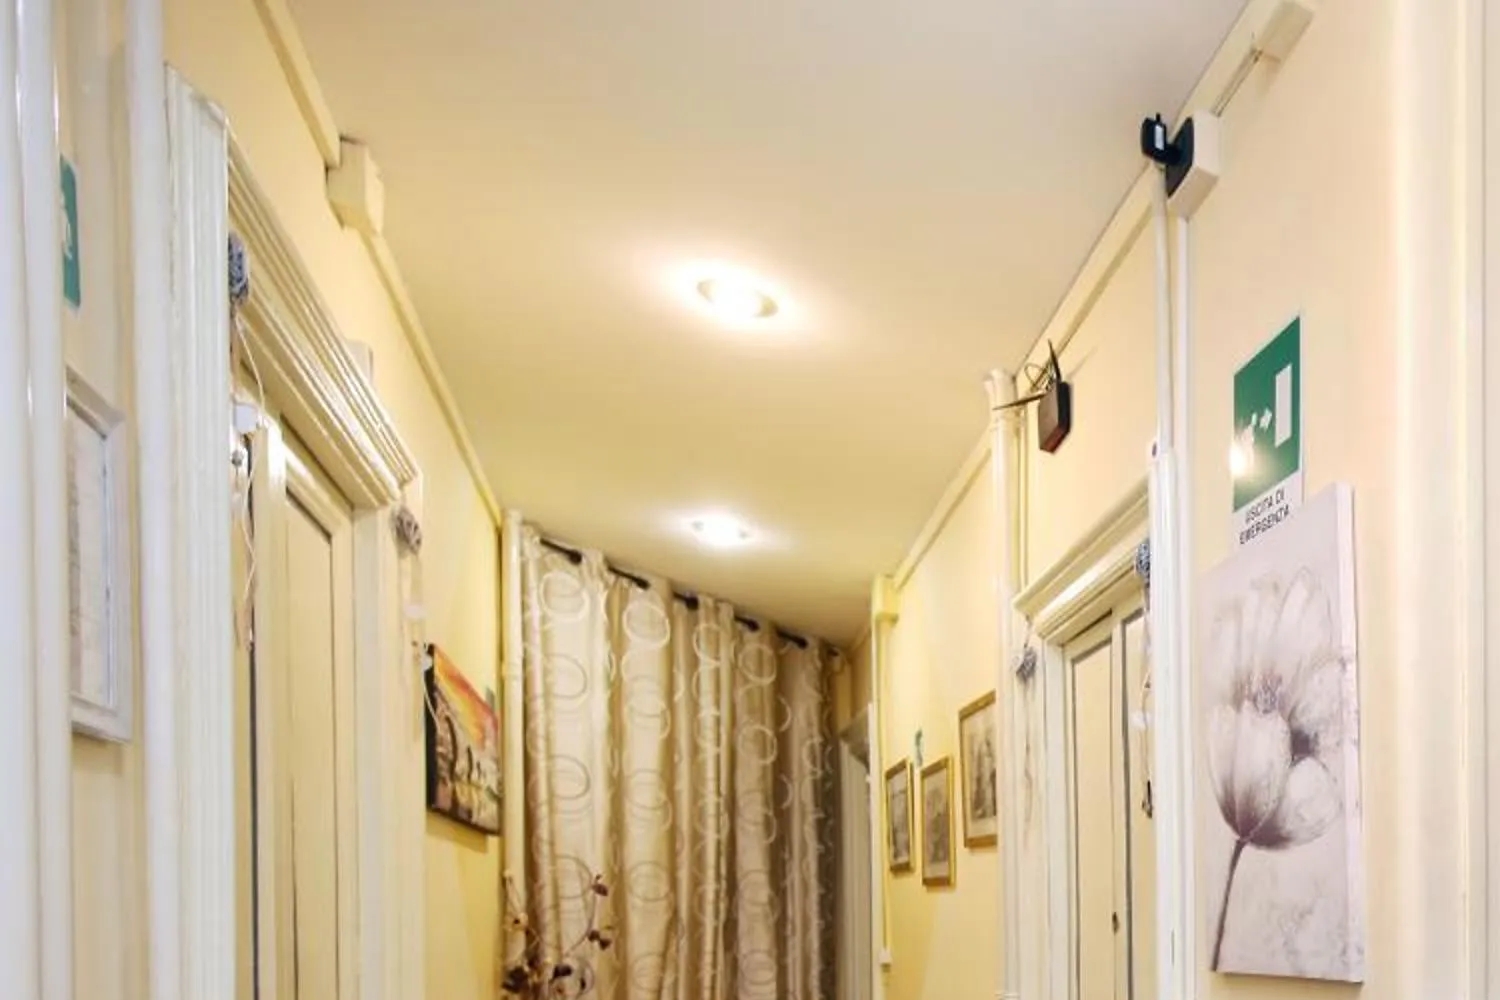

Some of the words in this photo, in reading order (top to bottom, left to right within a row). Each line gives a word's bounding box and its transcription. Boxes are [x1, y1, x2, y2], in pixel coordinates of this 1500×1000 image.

[1239, 504, 1290, 545] EMERGENZA
[1245, 495, 1273, 525] USCITA
[1275, 488, 1285, 505] DI
